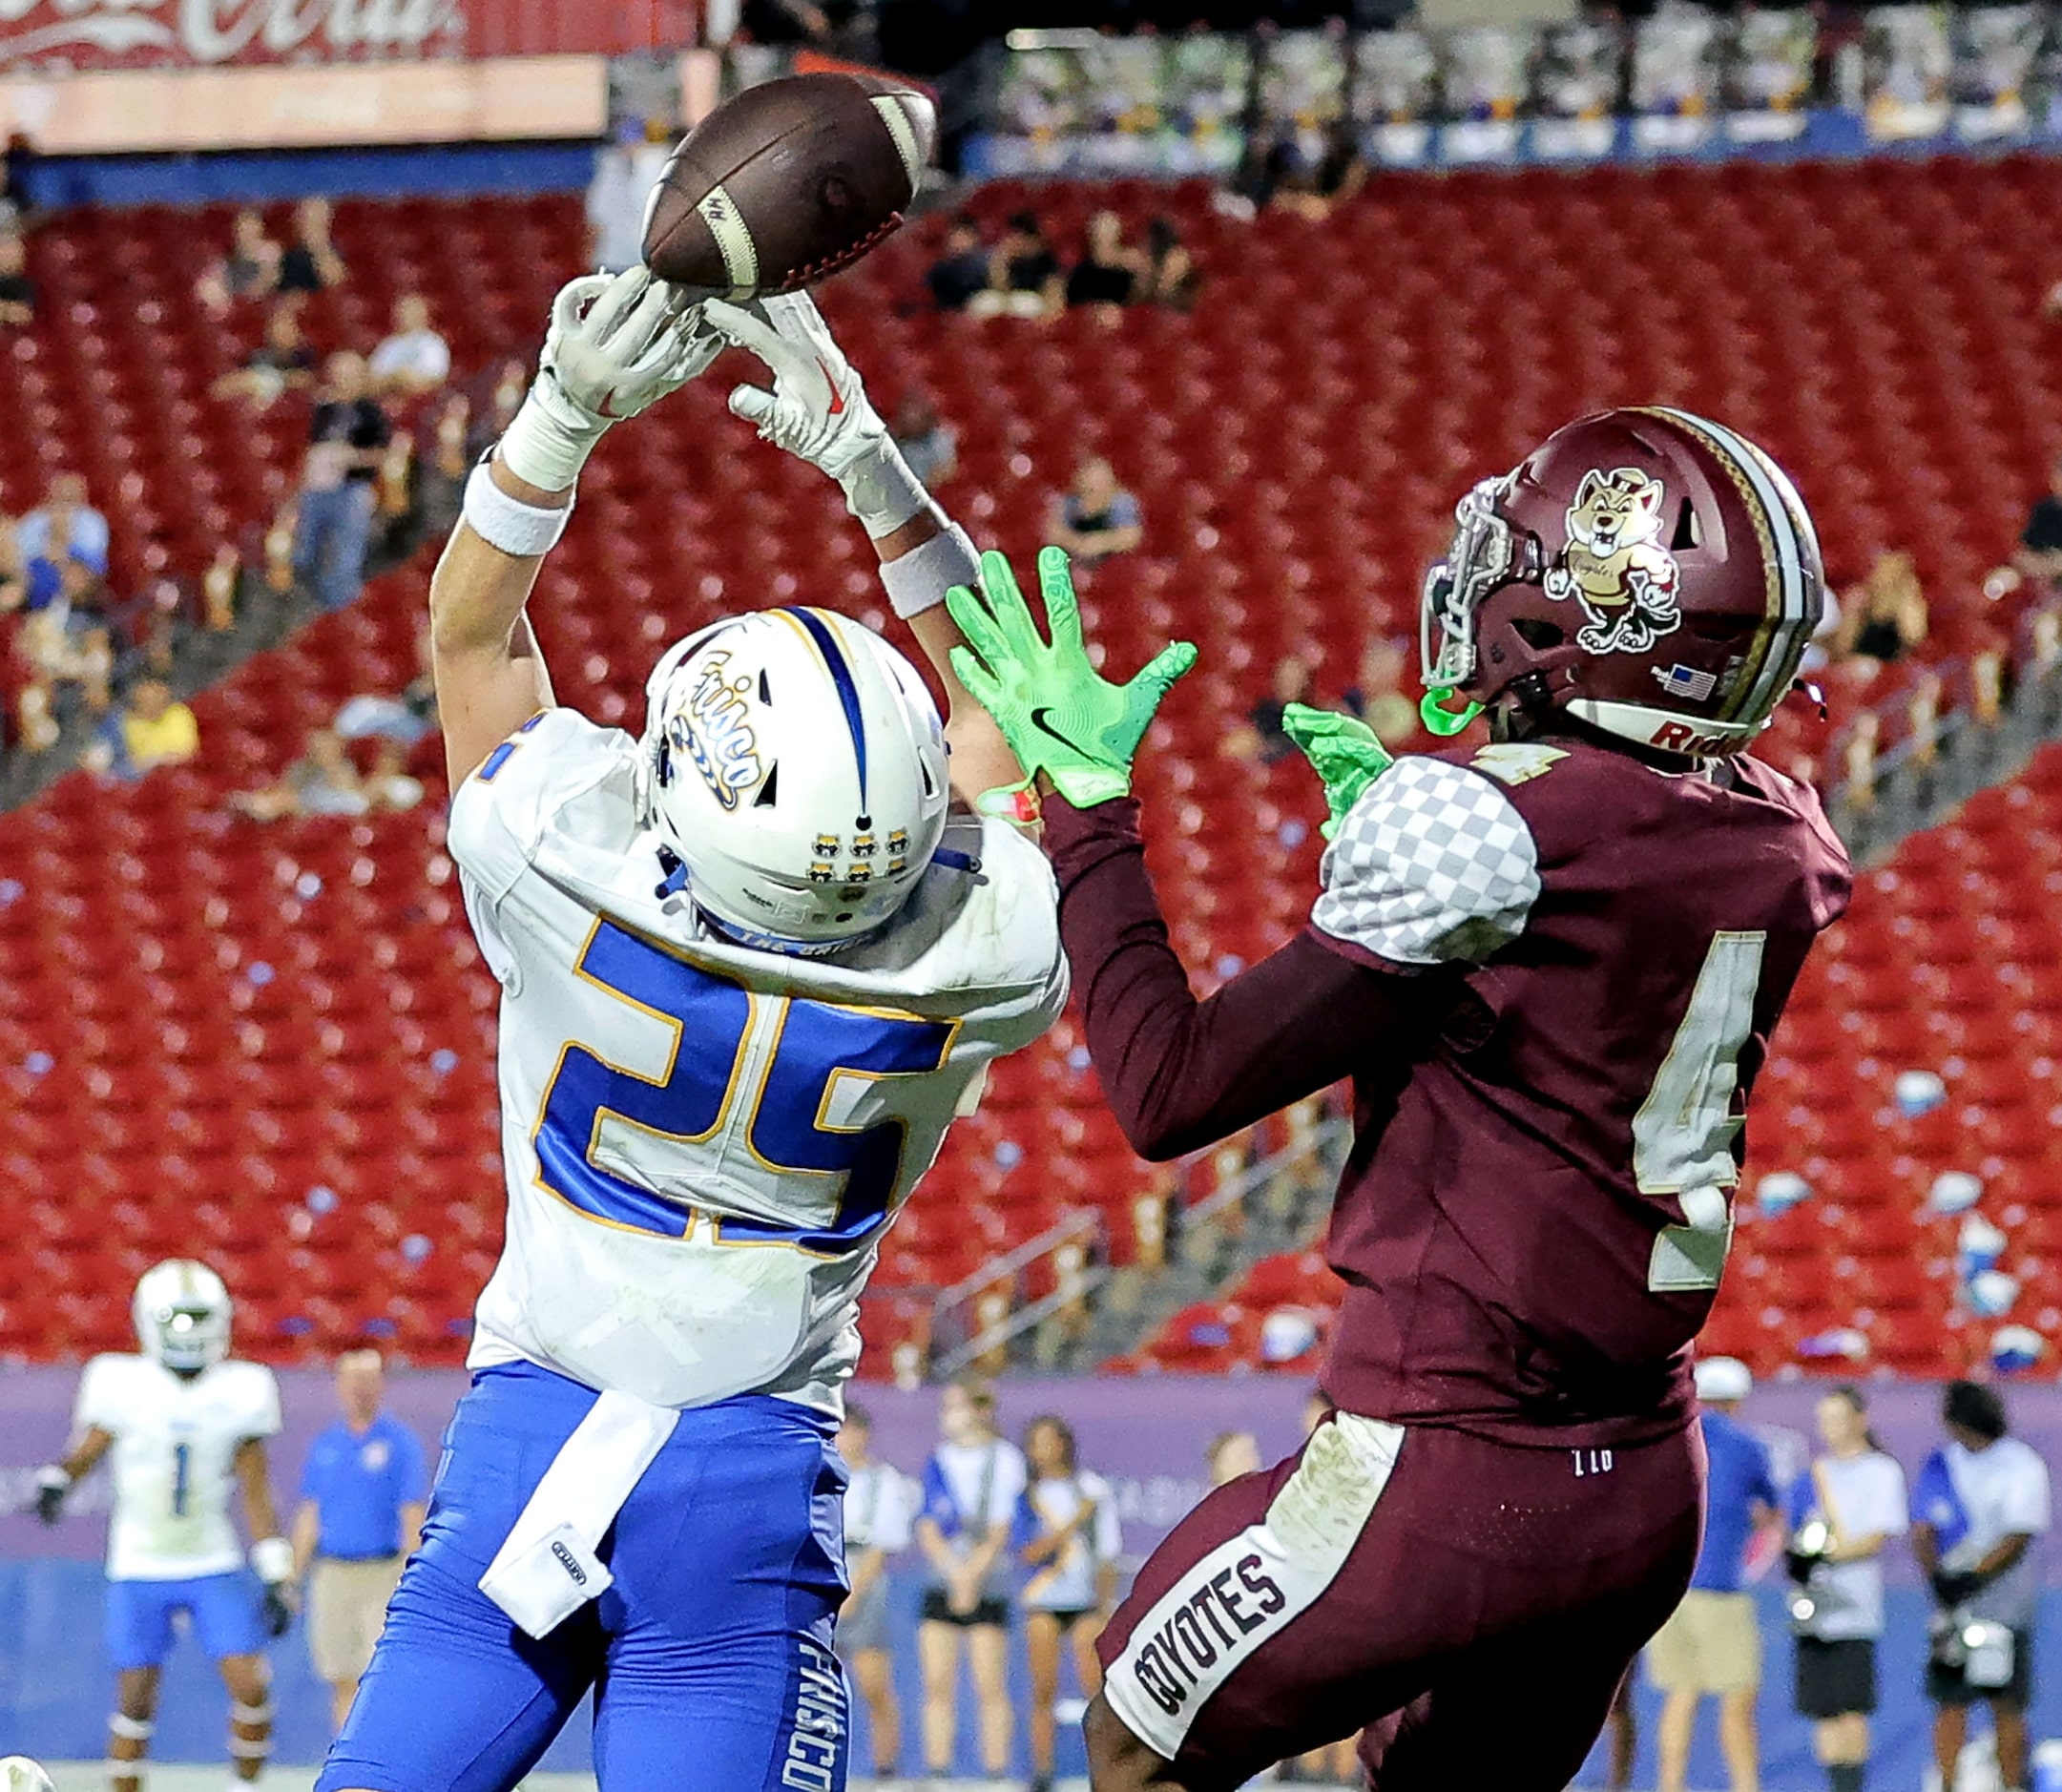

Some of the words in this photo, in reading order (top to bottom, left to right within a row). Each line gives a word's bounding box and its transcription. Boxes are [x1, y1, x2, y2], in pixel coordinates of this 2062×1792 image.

[531, 910, 963, 1261] 25
[1632, 930, 1767, 1293] 4
[174, 1443, 192, 1517] 1
[1135, 1553, 1285, 1716] COYOTES
[781, 1643, 846, 1792] FRISCO
